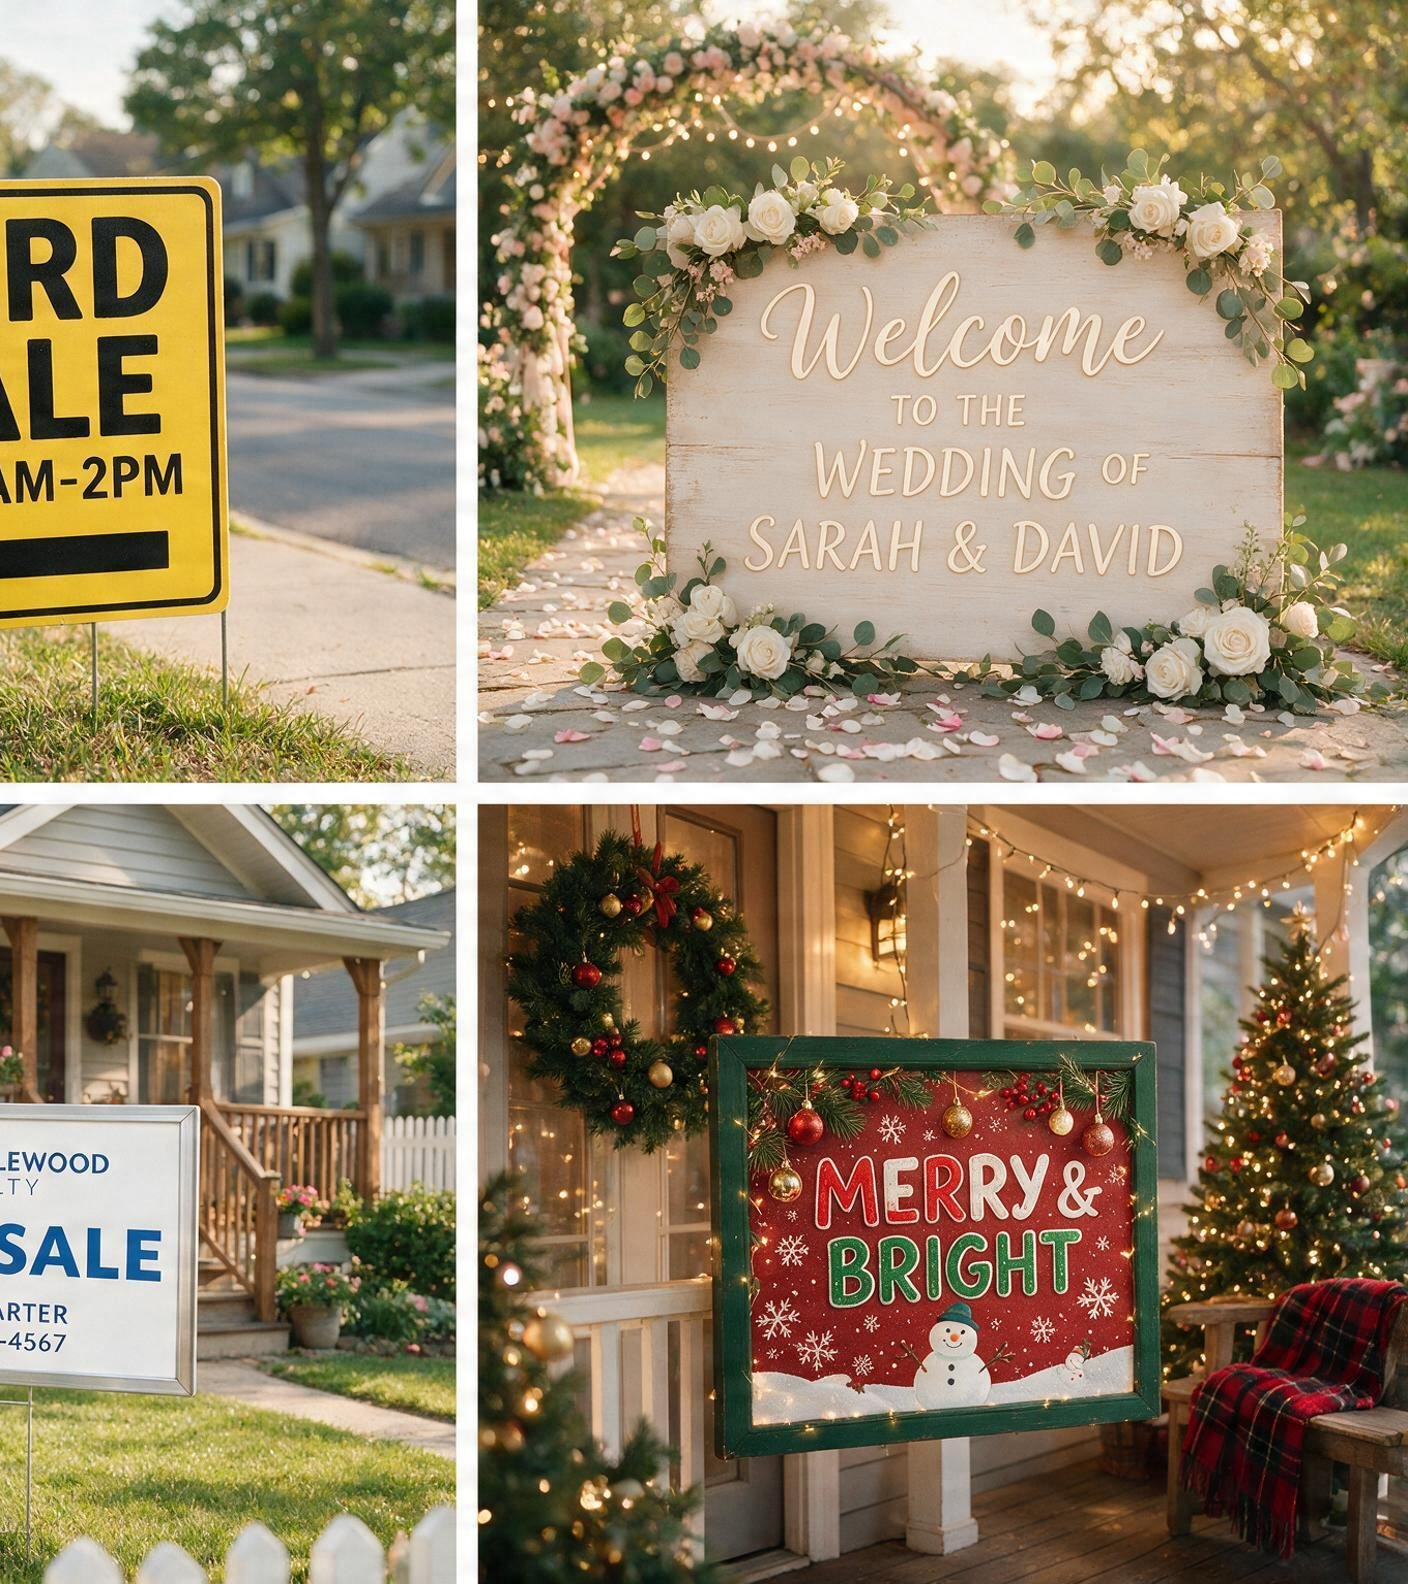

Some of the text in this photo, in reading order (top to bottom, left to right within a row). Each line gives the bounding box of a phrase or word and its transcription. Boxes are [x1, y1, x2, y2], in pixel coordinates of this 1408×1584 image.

[760, 271, 1164, 379] Welcome
[891, 393, 1025, 427] TO THE
[814, 440, 1150, 500] WEDDING OF
[744, 515, 1184, 577] SARAH & DAVID
[816, 1152, 1103, 1230] MERRY &
[828, 1229, 1082, 1309] BRIGHT
